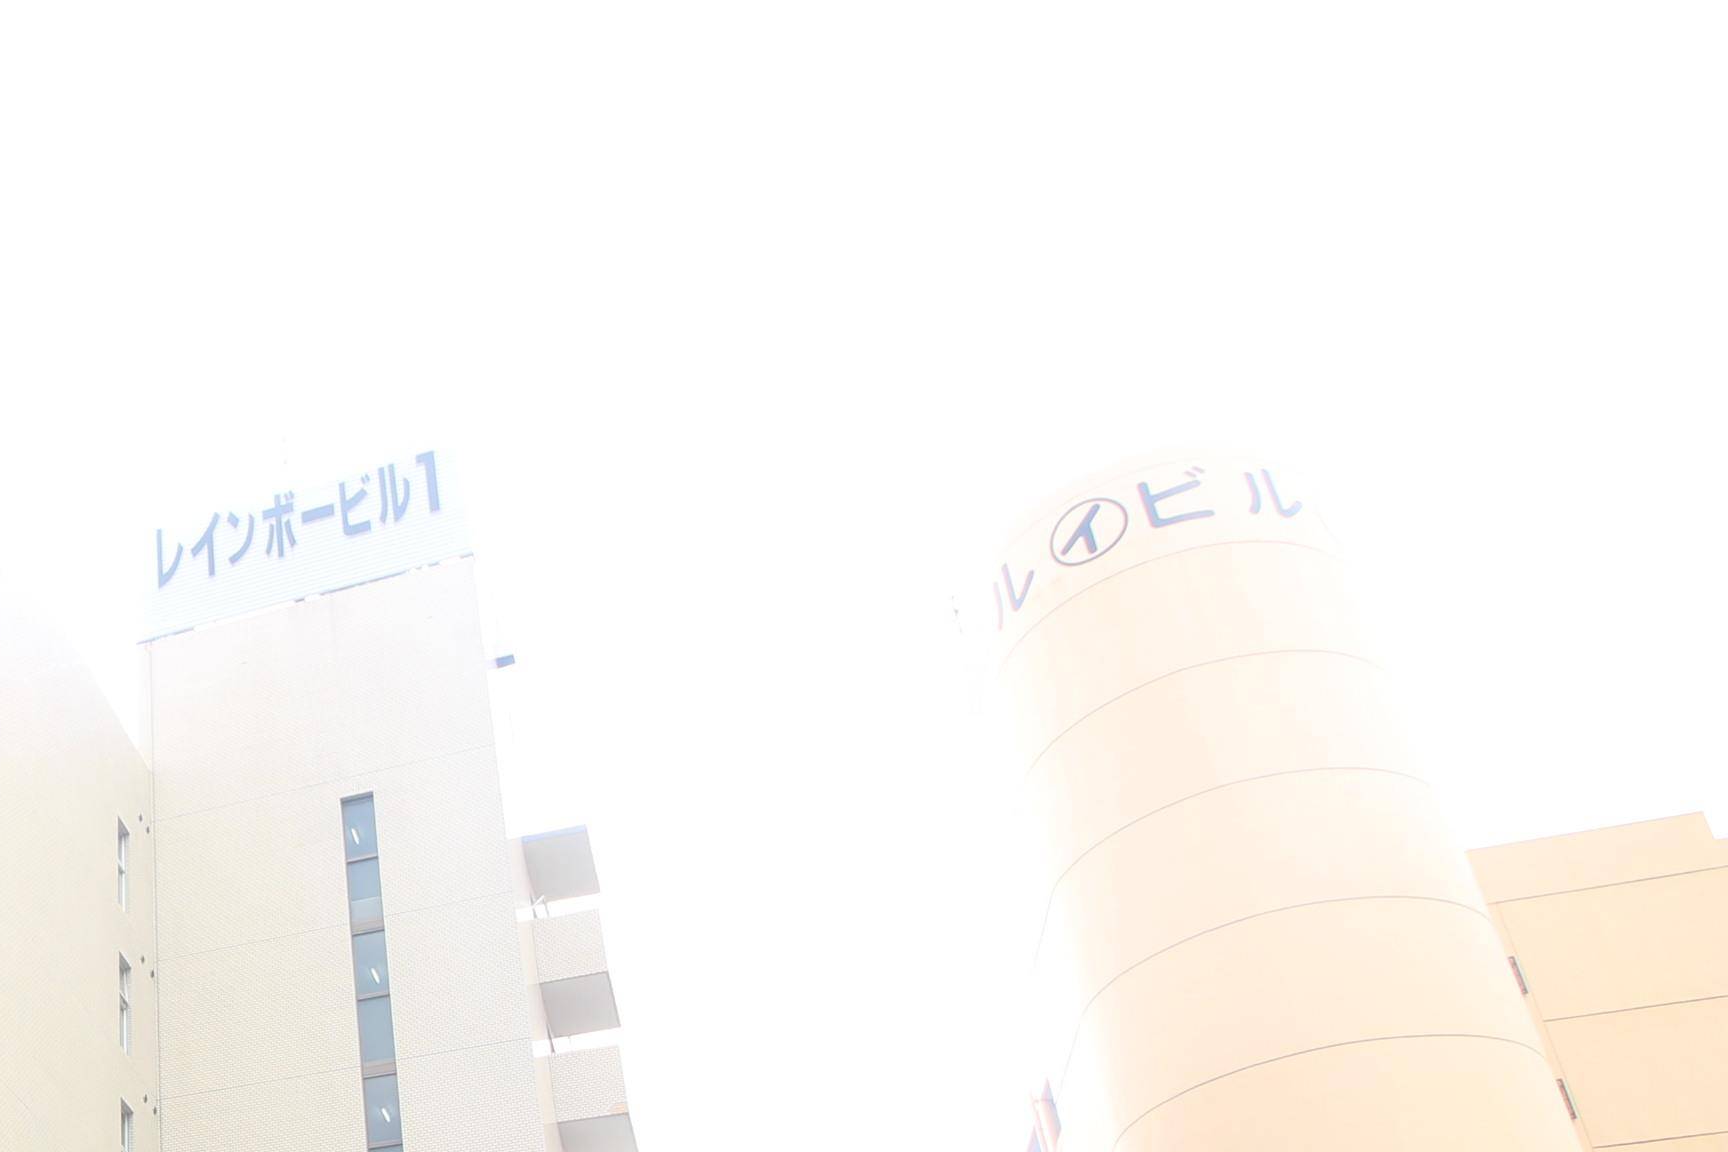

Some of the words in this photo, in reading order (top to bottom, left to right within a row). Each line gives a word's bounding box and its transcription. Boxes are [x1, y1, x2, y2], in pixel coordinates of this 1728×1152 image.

[156, 450, 440, 590] レインボービル1
